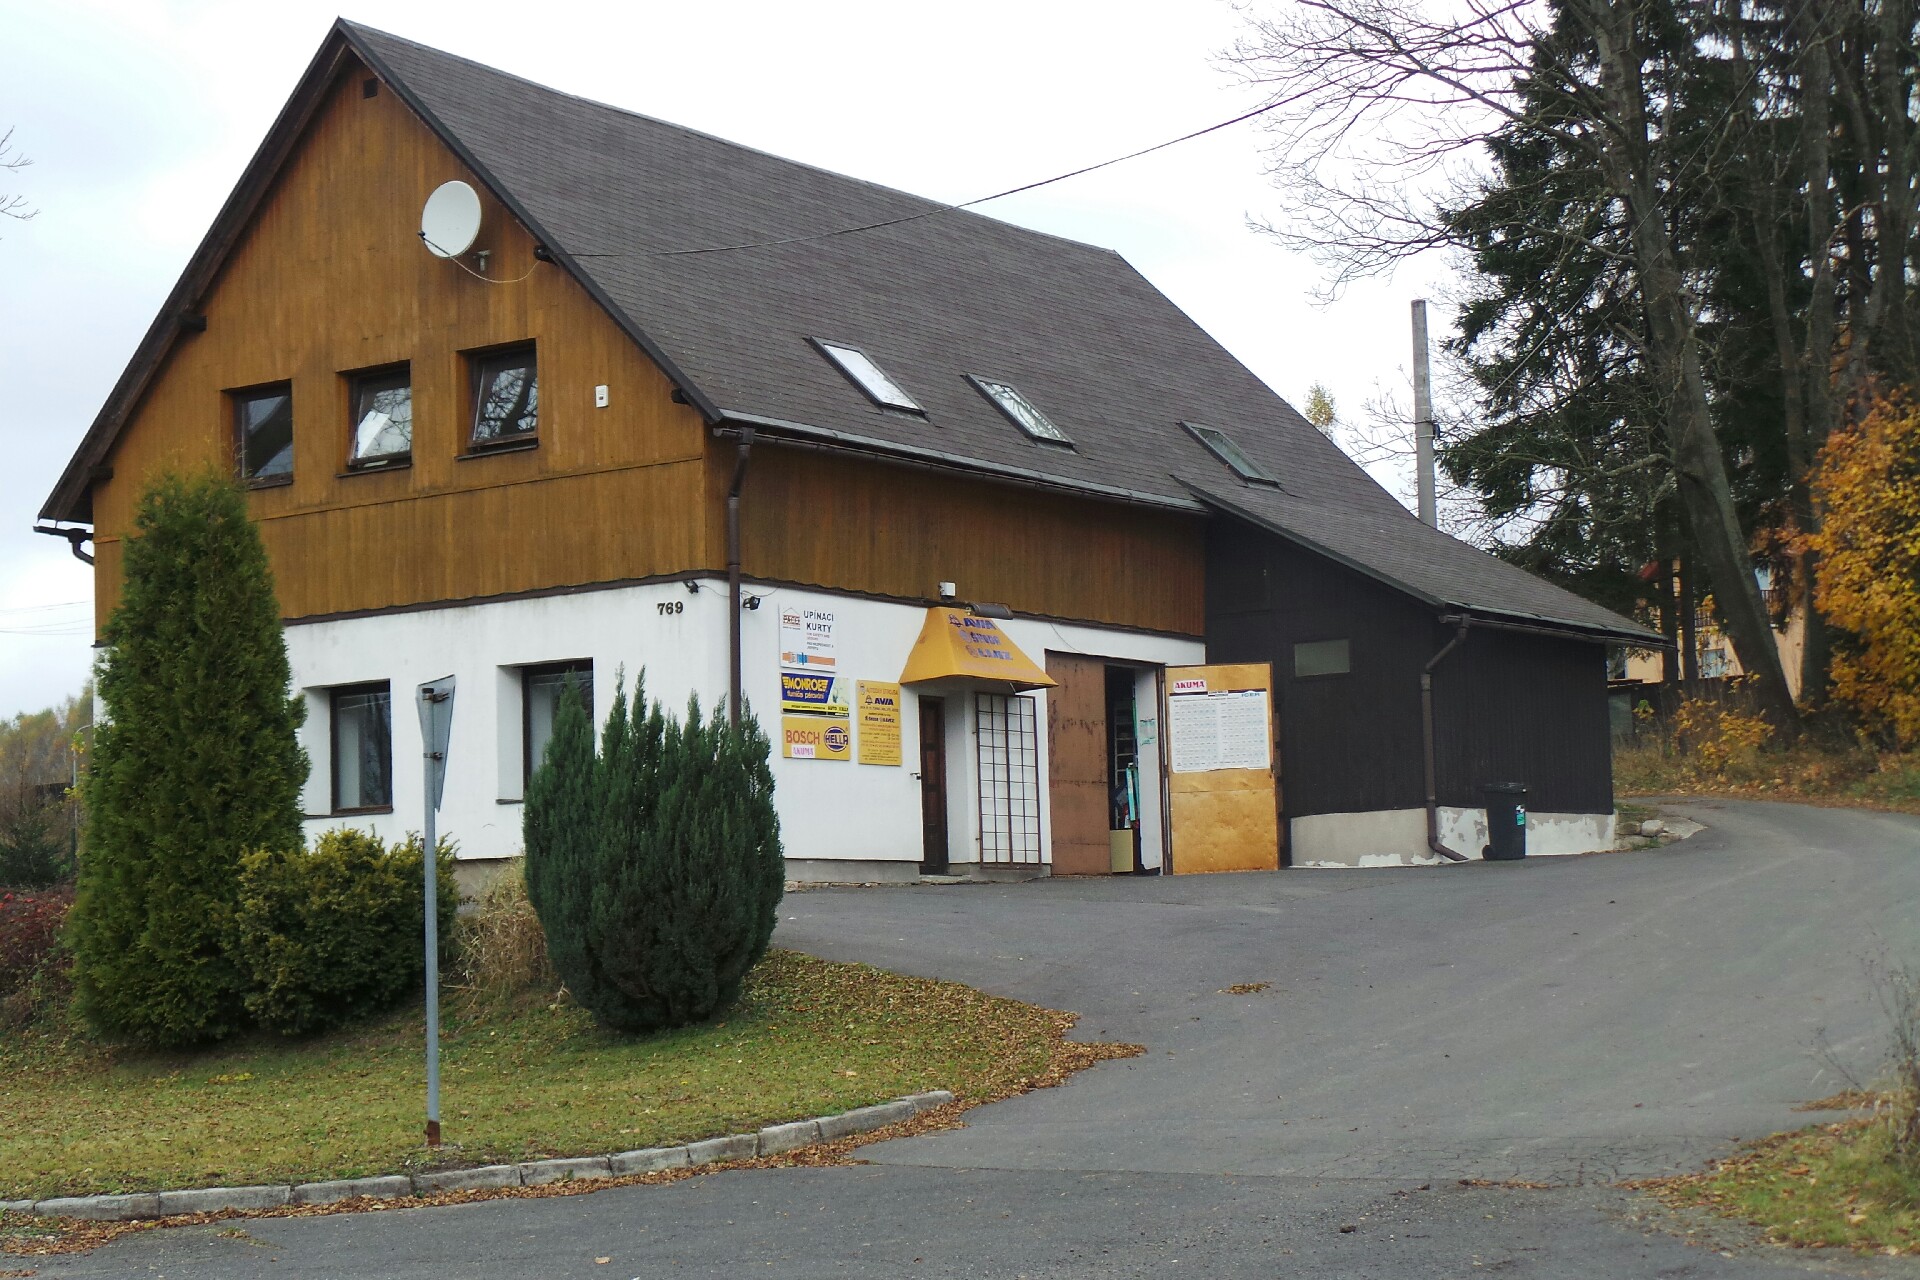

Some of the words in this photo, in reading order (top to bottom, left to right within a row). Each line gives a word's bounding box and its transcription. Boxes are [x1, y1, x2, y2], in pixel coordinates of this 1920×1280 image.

[657, 601, 683, 615] 769
[806, 622, 832, 632] KURTY
[782, 676, 828, 692] MONROE
[1175, 681, 1204, 689] AKUMA
[874, 698, 894, 706] AVIA
[786, 730, 820, 745] BOSCH
[825, 734, 849, 745] HELLA
